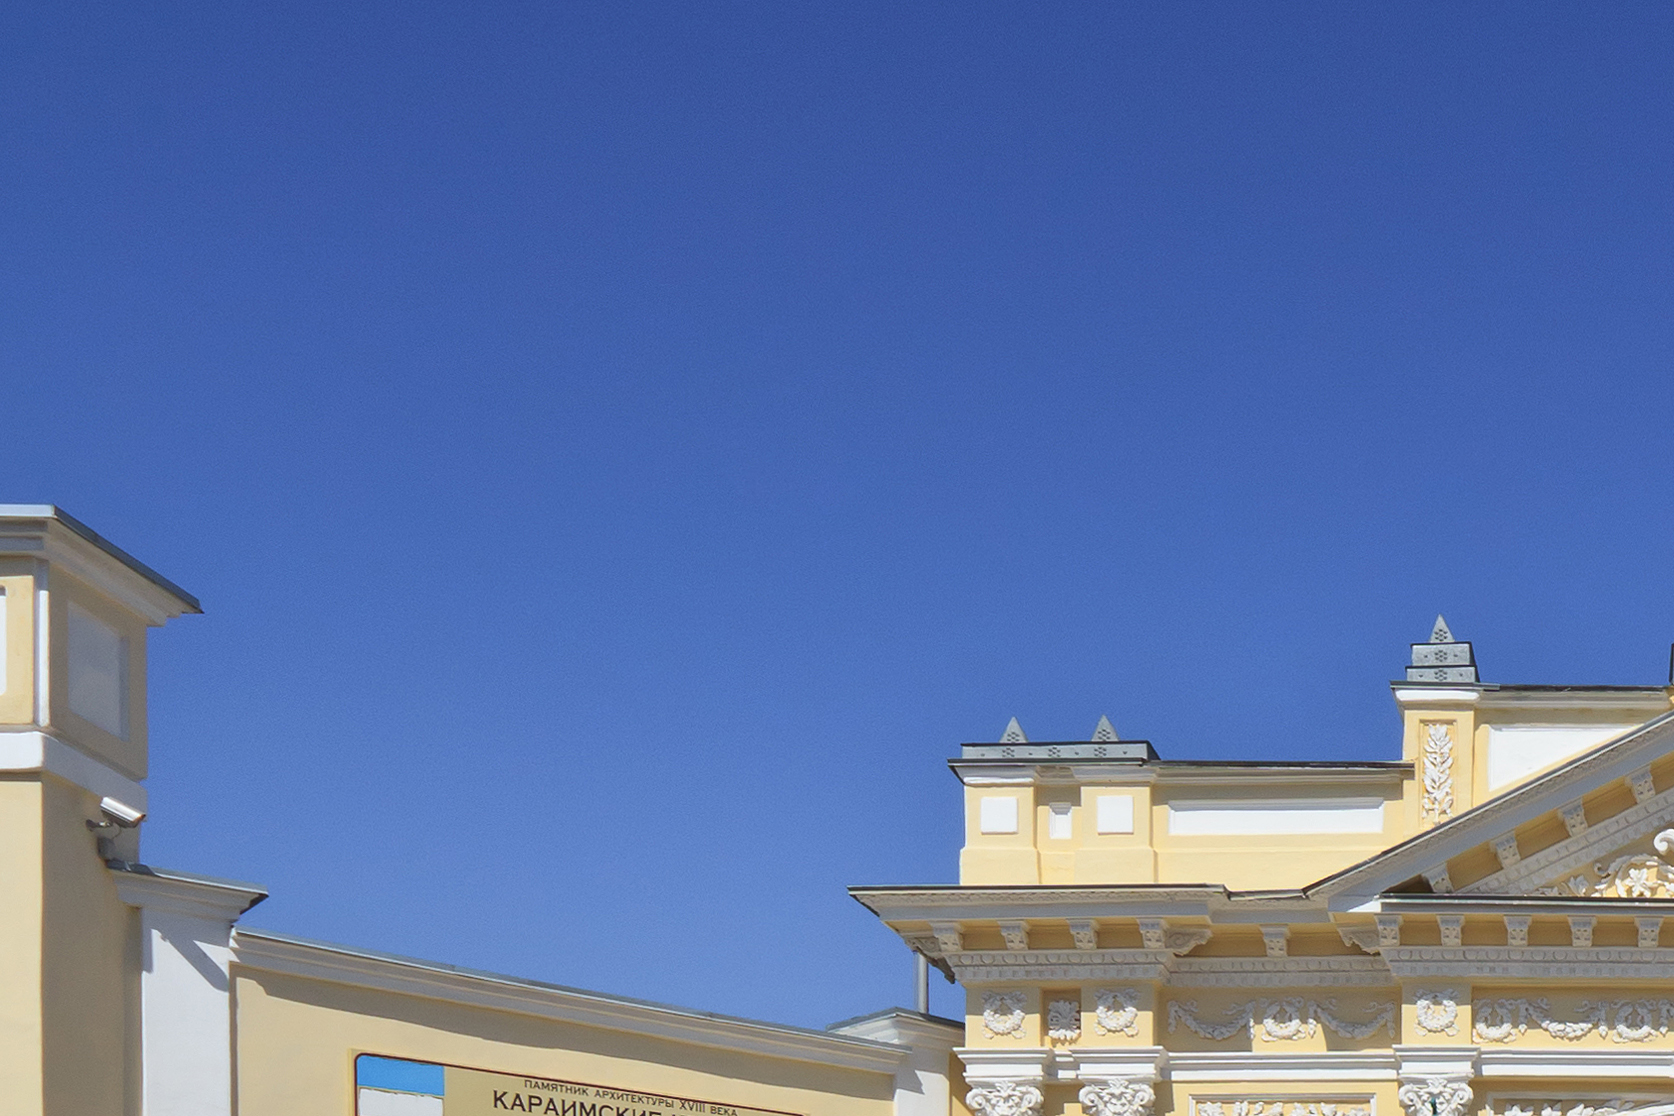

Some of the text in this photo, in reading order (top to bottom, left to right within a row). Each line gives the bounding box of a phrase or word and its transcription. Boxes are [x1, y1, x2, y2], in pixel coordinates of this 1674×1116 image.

[524, 1079, 738, 1116] ПАМЯТНИК АРХИТЕКТУРЫ XVIII ВЕКА
